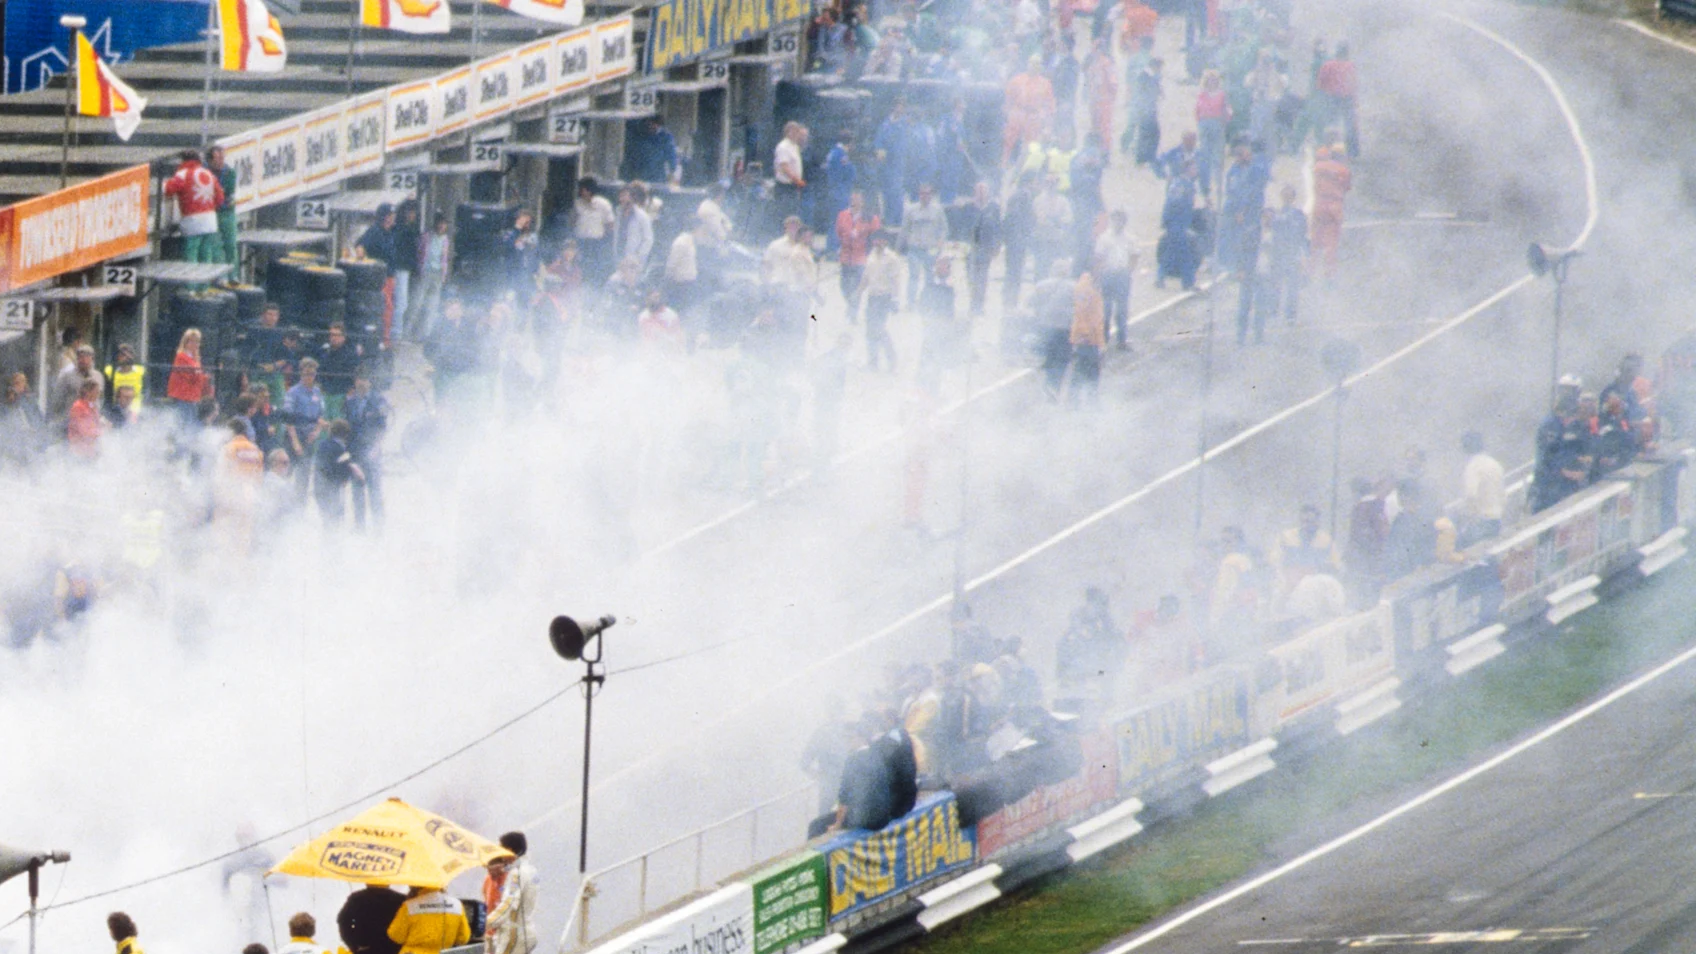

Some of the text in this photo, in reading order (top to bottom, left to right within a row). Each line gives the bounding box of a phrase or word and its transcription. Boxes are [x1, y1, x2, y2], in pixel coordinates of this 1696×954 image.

[703, 64, 726, 79] 29
[630, 91, 654, 106] 28
[555, 119, 577, 133] 27
[475, 147, 499, 162] 26
[392, 174, 415, 189] 25
[302, 203, 326, 218] 24
[108, 269, 133, 285] 22
[7, 302, 30, 317] 21
[344, 826, 408, 838] RENAULT
[830, 825, 899, 917] DAILY
[905, 802, 974, 883] MAIL
